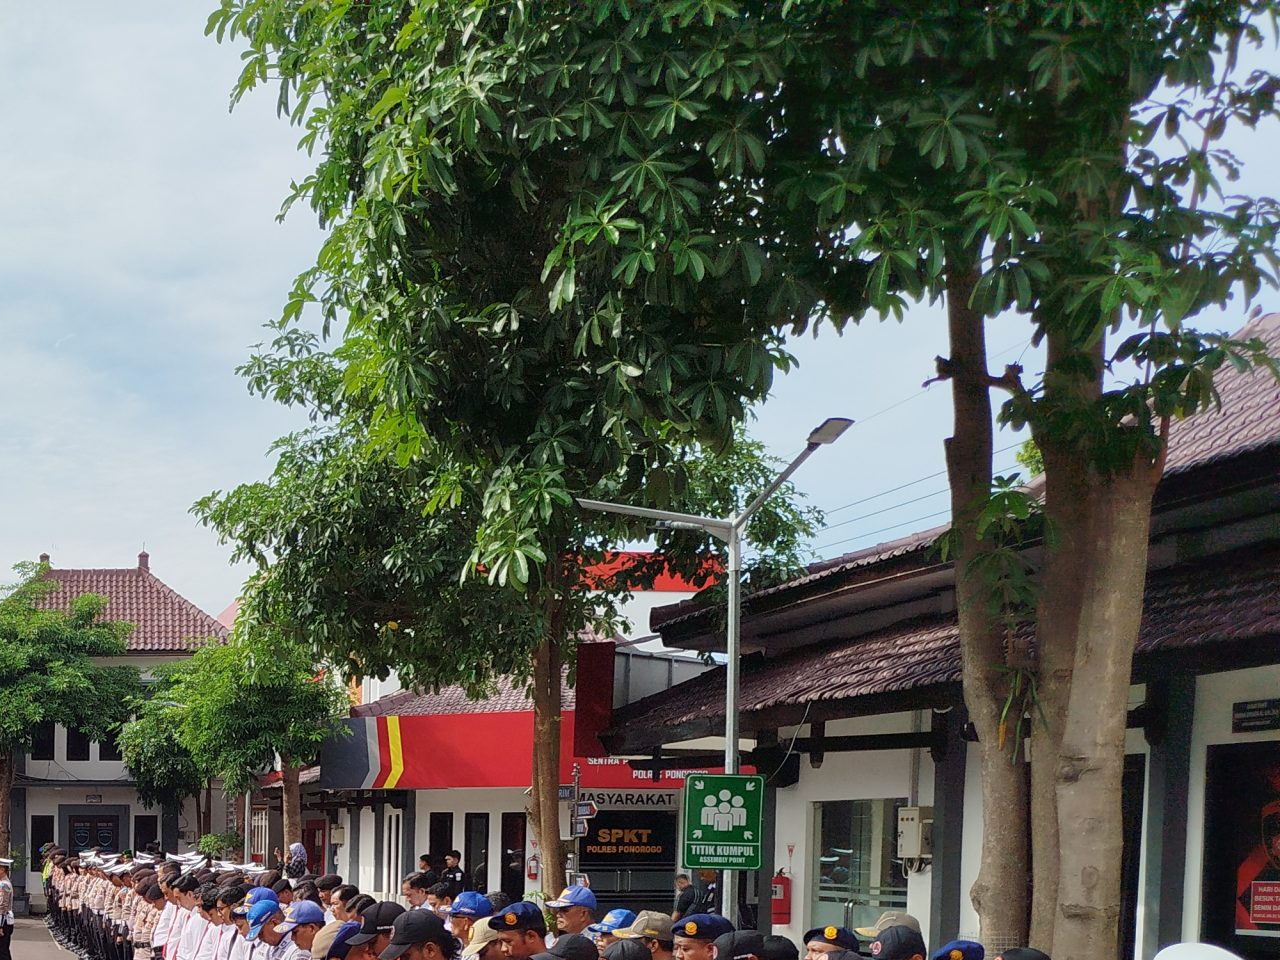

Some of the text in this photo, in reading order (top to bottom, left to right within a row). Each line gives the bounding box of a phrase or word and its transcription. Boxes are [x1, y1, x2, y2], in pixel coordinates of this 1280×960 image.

[579, 793, 675, 806] MASYARAKAT
[597, 829, 652, 843] SPKT
[587, 845, 662, 853] POLRES PONOROGO
[691, 845, 754, 856] TITIK KUMPUL
